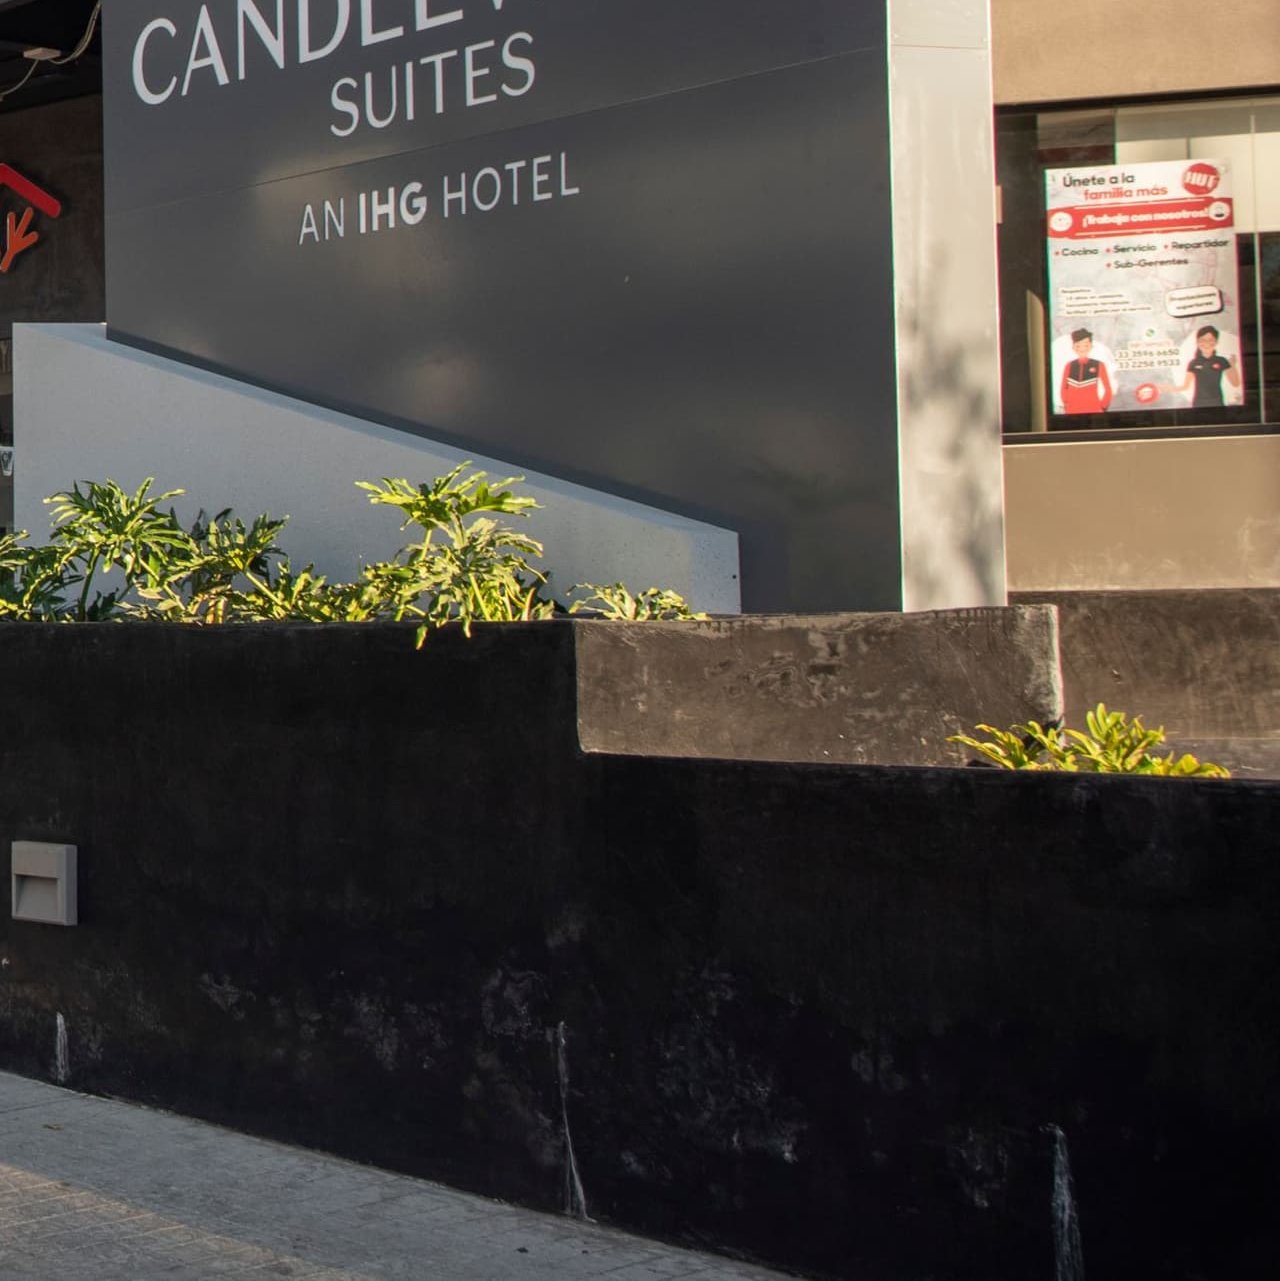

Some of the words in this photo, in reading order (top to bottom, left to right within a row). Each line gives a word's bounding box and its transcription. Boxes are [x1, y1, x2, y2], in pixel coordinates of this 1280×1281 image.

[330, 32, 535, 137] SUITES
[1063, 172, 1107, 189] Únete
[1109, 176, 1118, 185] a
[1121, 173, 1135, 184] la
[298, 198, 345, 245] AN
[358, 182, 428, 234] IHG
[443, 152, 580, 218] HOTEL
[1084, 186, 1133, 201] familia
[1136, 184, 1168, 197] más
[1131, 213, 1152, 222] con
[1113, 243, 1157, 254] Servicio
[1171, 238, 1229, 251] Repartidor
[1061, 248, 1099, 257] Cocina
[1114, 258, 1189, 269] Sub-Gerentes
